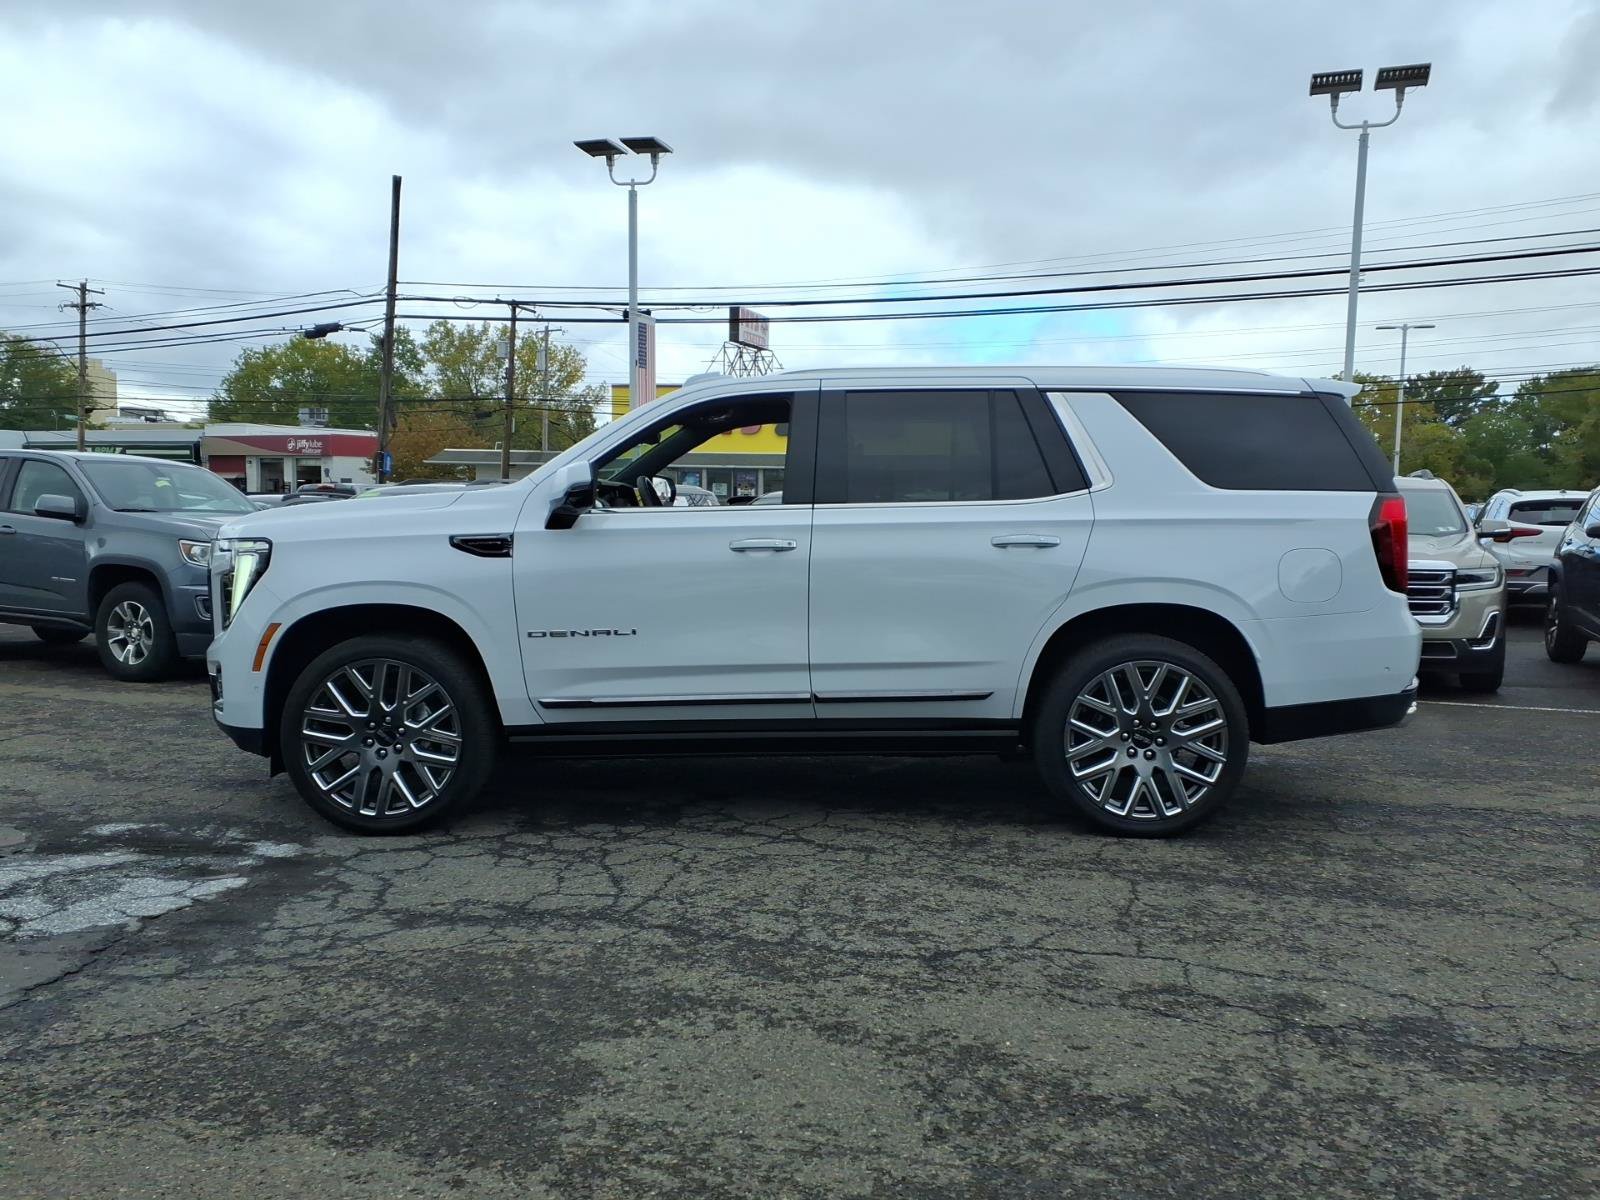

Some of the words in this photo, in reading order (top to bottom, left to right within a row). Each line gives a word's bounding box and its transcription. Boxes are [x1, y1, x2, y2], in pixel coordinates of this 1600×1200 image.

[296, 439, 310, 450] jiffy
[310, 439, 323, 448] lube
[527, 628, 637, 638] DENALI
